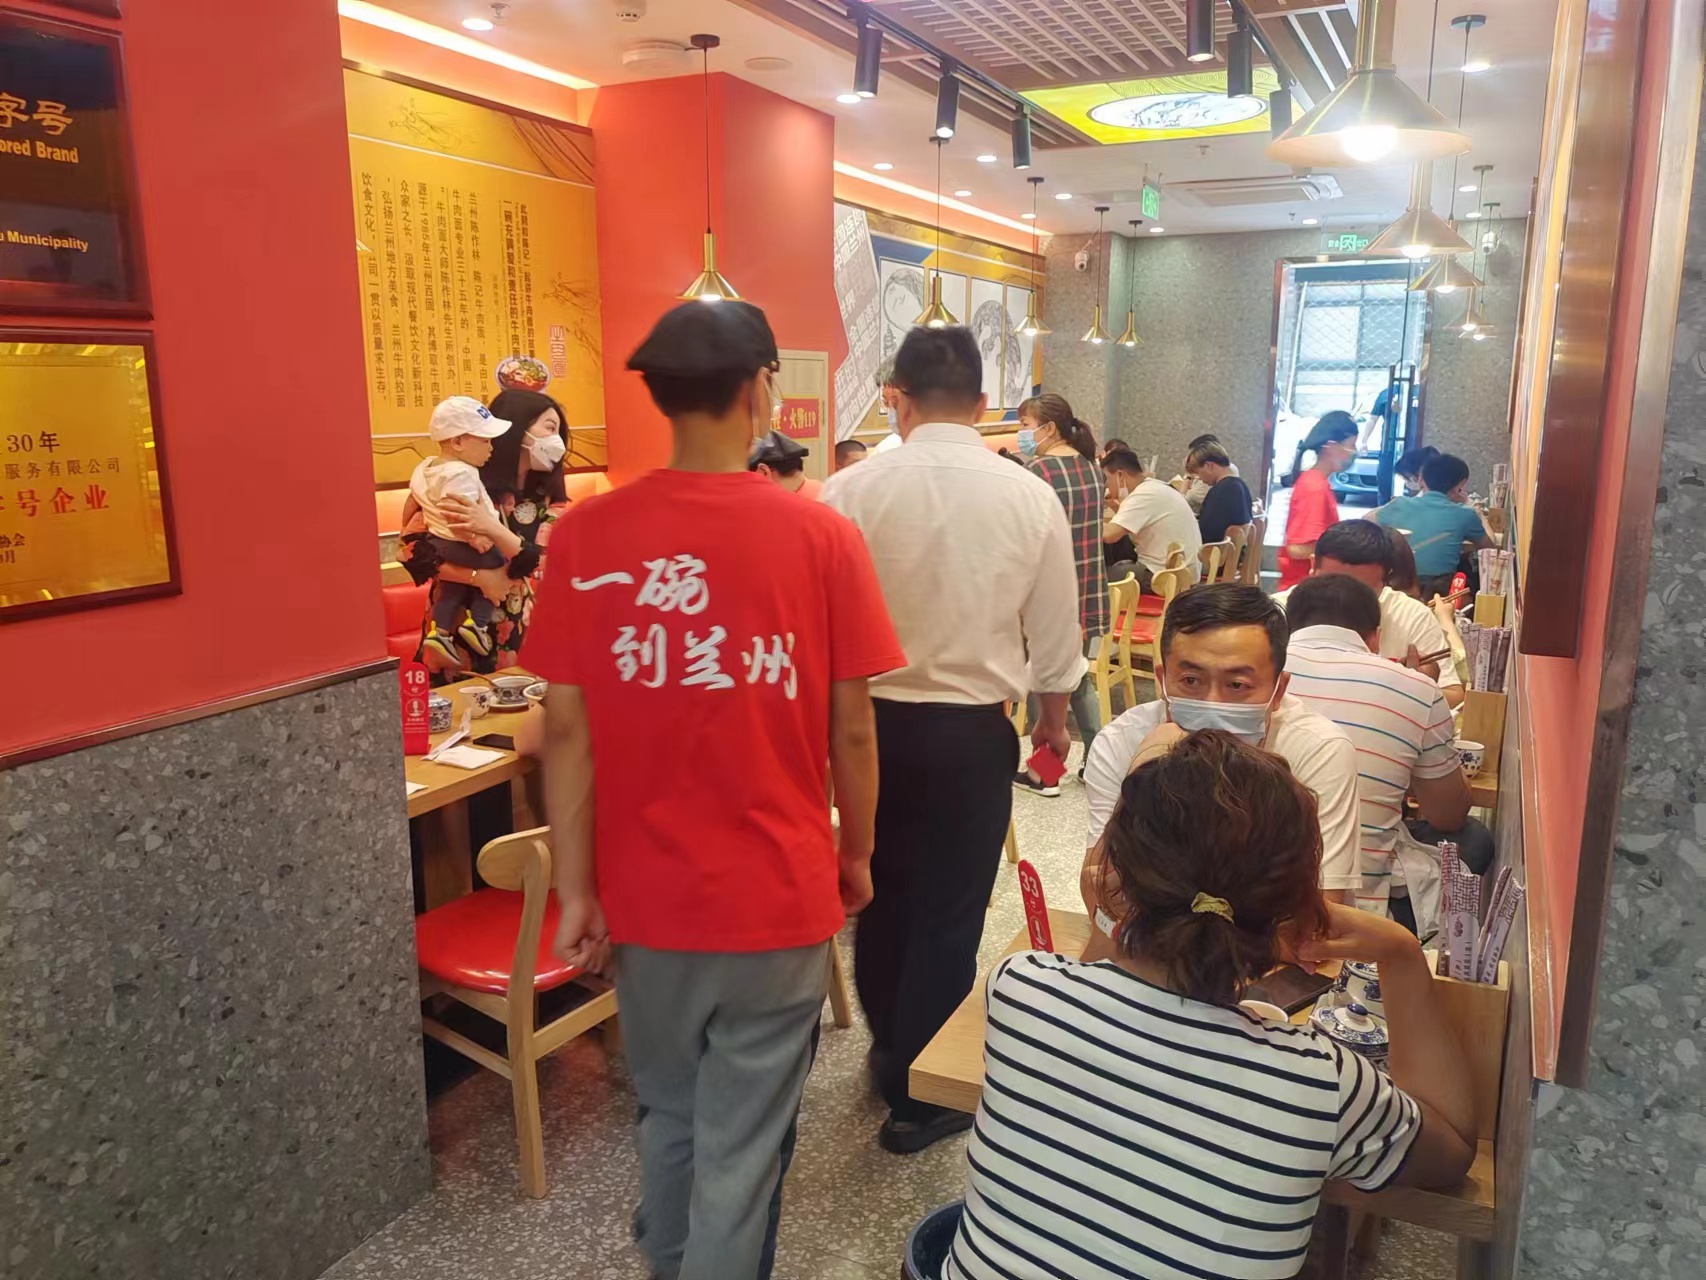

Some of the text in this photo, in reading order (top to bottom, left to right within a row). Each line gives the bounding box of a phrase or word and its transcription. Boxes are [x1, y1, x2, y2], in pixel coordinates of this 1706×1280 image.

[0, 92, 73, 136] 字号
[35, 140, 79, 164] Brand
[7, 230, 88, 252] Municipality
[5, 457, 120, 480] 服务有限公司
[0, 484, 110, 518] 号企业
[571, 553, 710, 616] 一碗
[611, 623, 798, 701] 到兰州
[404, 670, 425, 684] 18
[1020, 870, 1040, 898] 33
